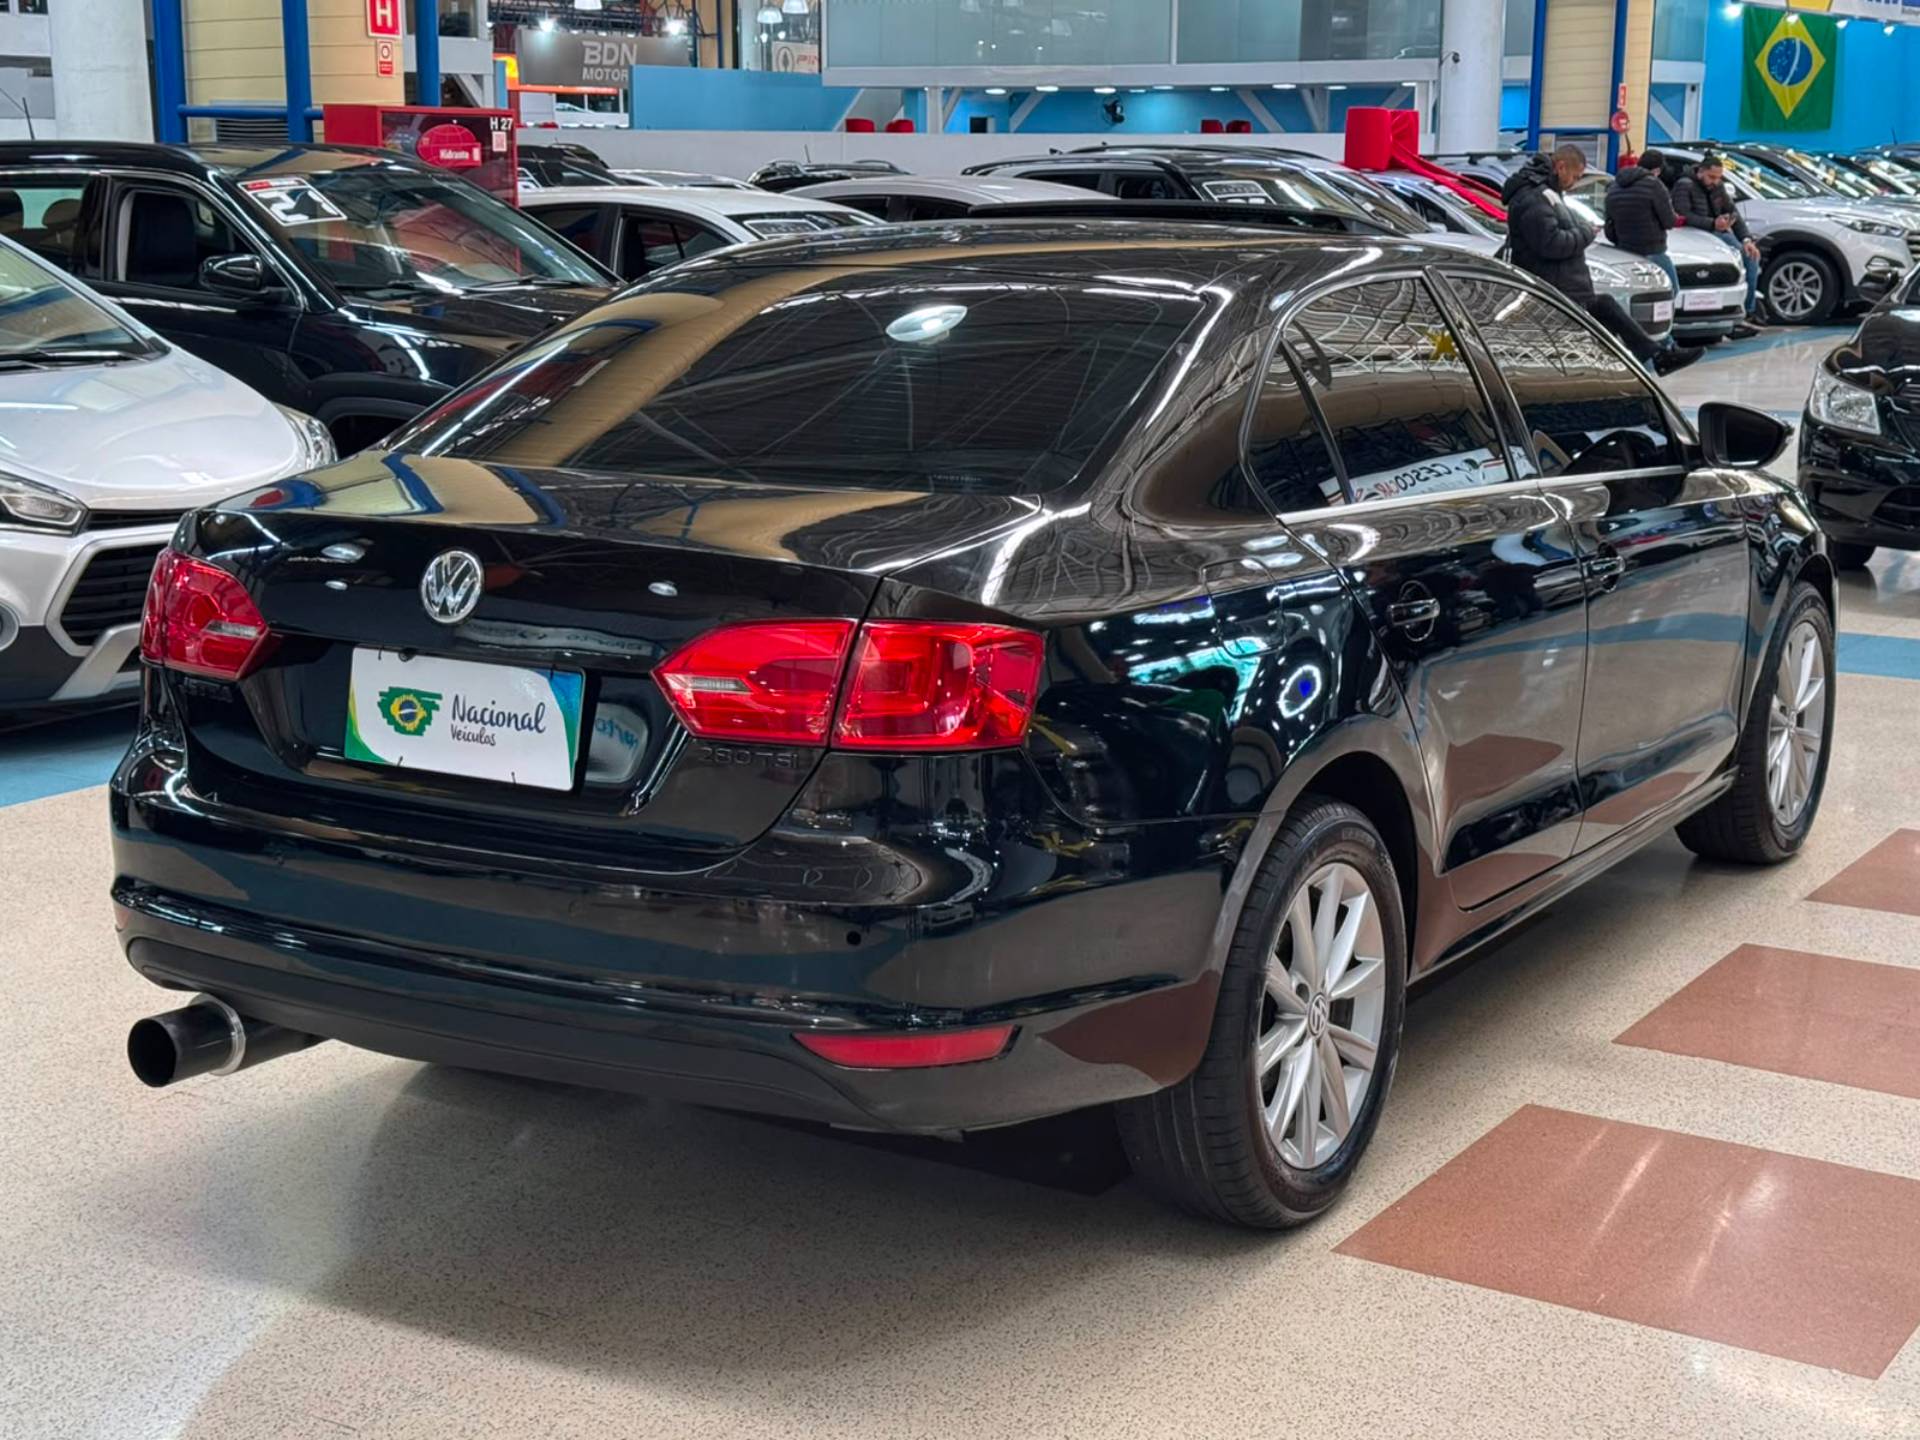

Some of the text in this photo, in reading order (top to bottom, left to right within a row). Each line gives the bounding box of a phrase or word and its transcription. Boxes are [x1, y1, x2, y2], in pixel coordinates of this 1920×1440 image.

[376, 0, 392, 27] H
[582, 41, 637, 66] BDN
[490, 116, 513, 131] H 27
[452, 693, 546, 734] Nacional
